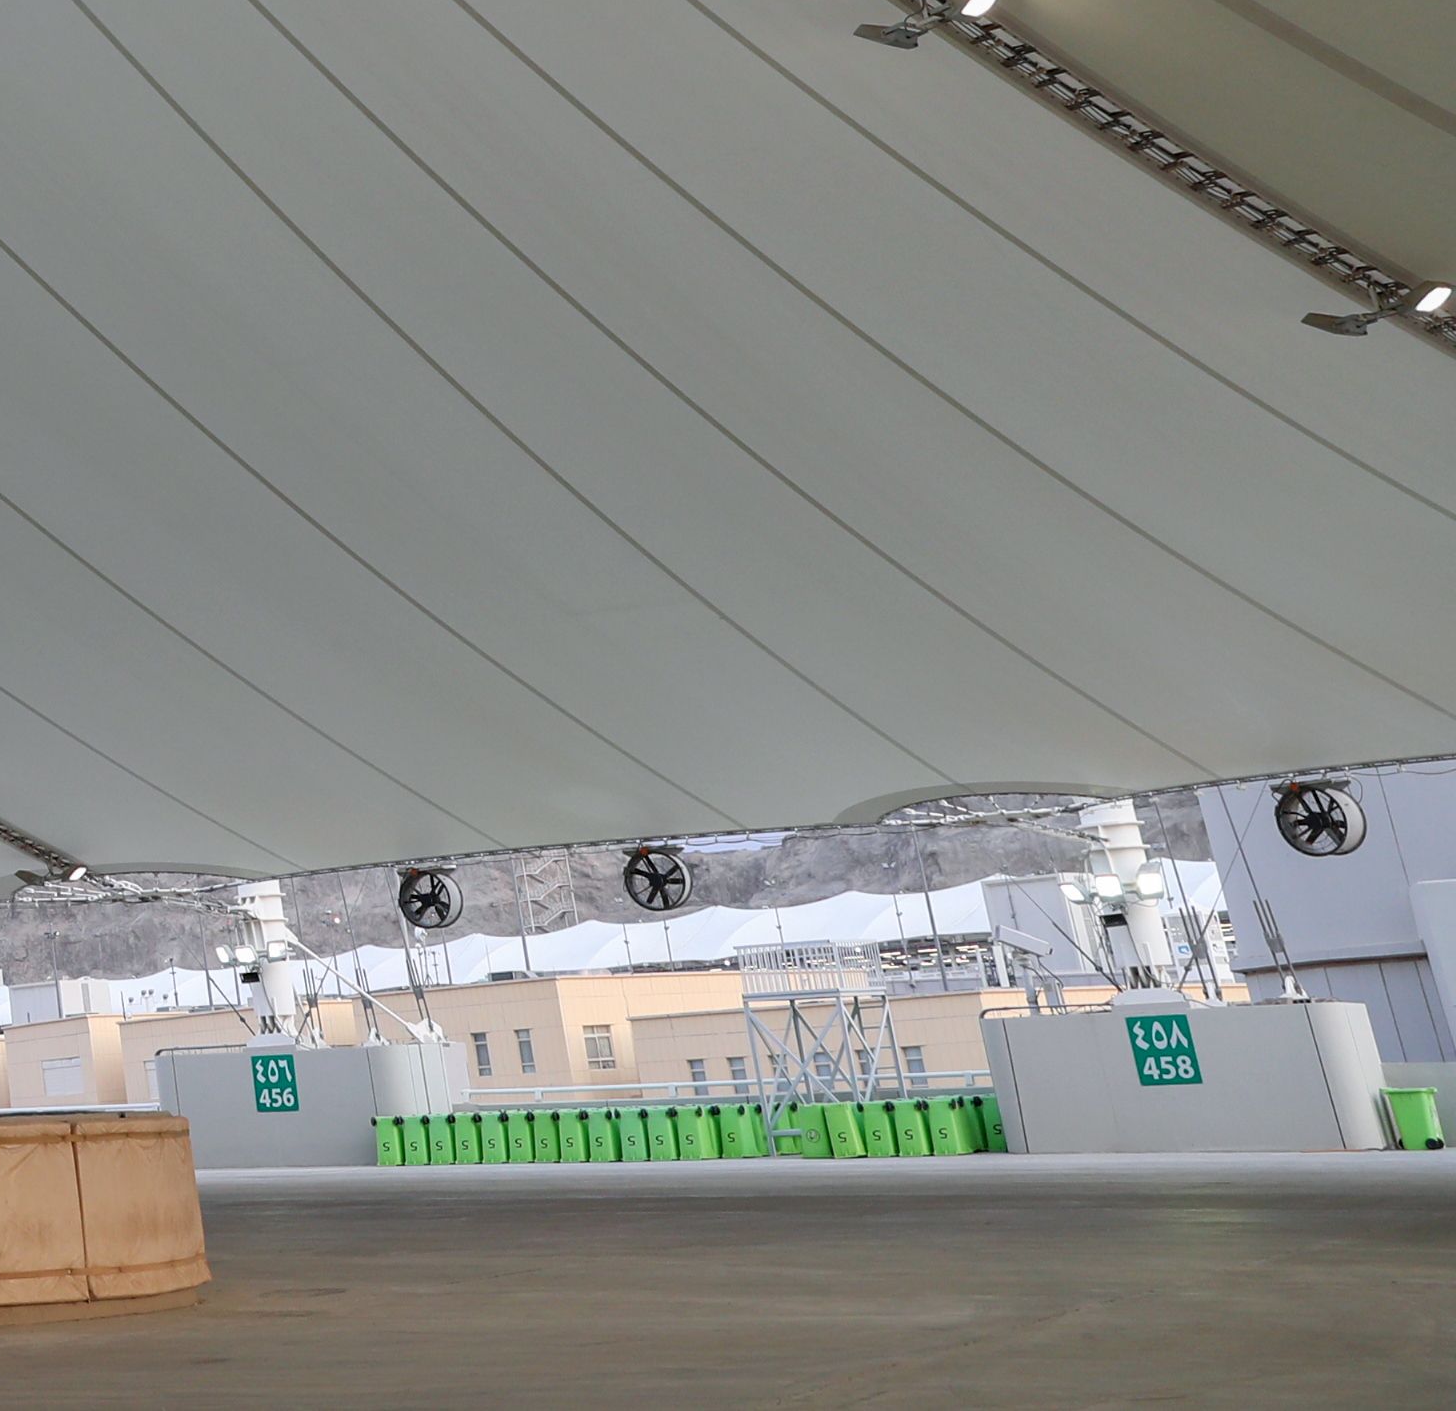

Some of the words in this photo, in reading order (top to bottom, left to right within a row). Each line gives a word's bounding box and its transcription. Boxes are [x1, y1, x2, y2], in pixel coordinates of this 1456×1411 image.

[1132, 1019, 1189, 1051] ٤٥٨
[255, 1059, 292, 1084] ٤٥٦
[1143, 1055, 1195, 1080] 458
[259, 1087, 295, 1108] 456
